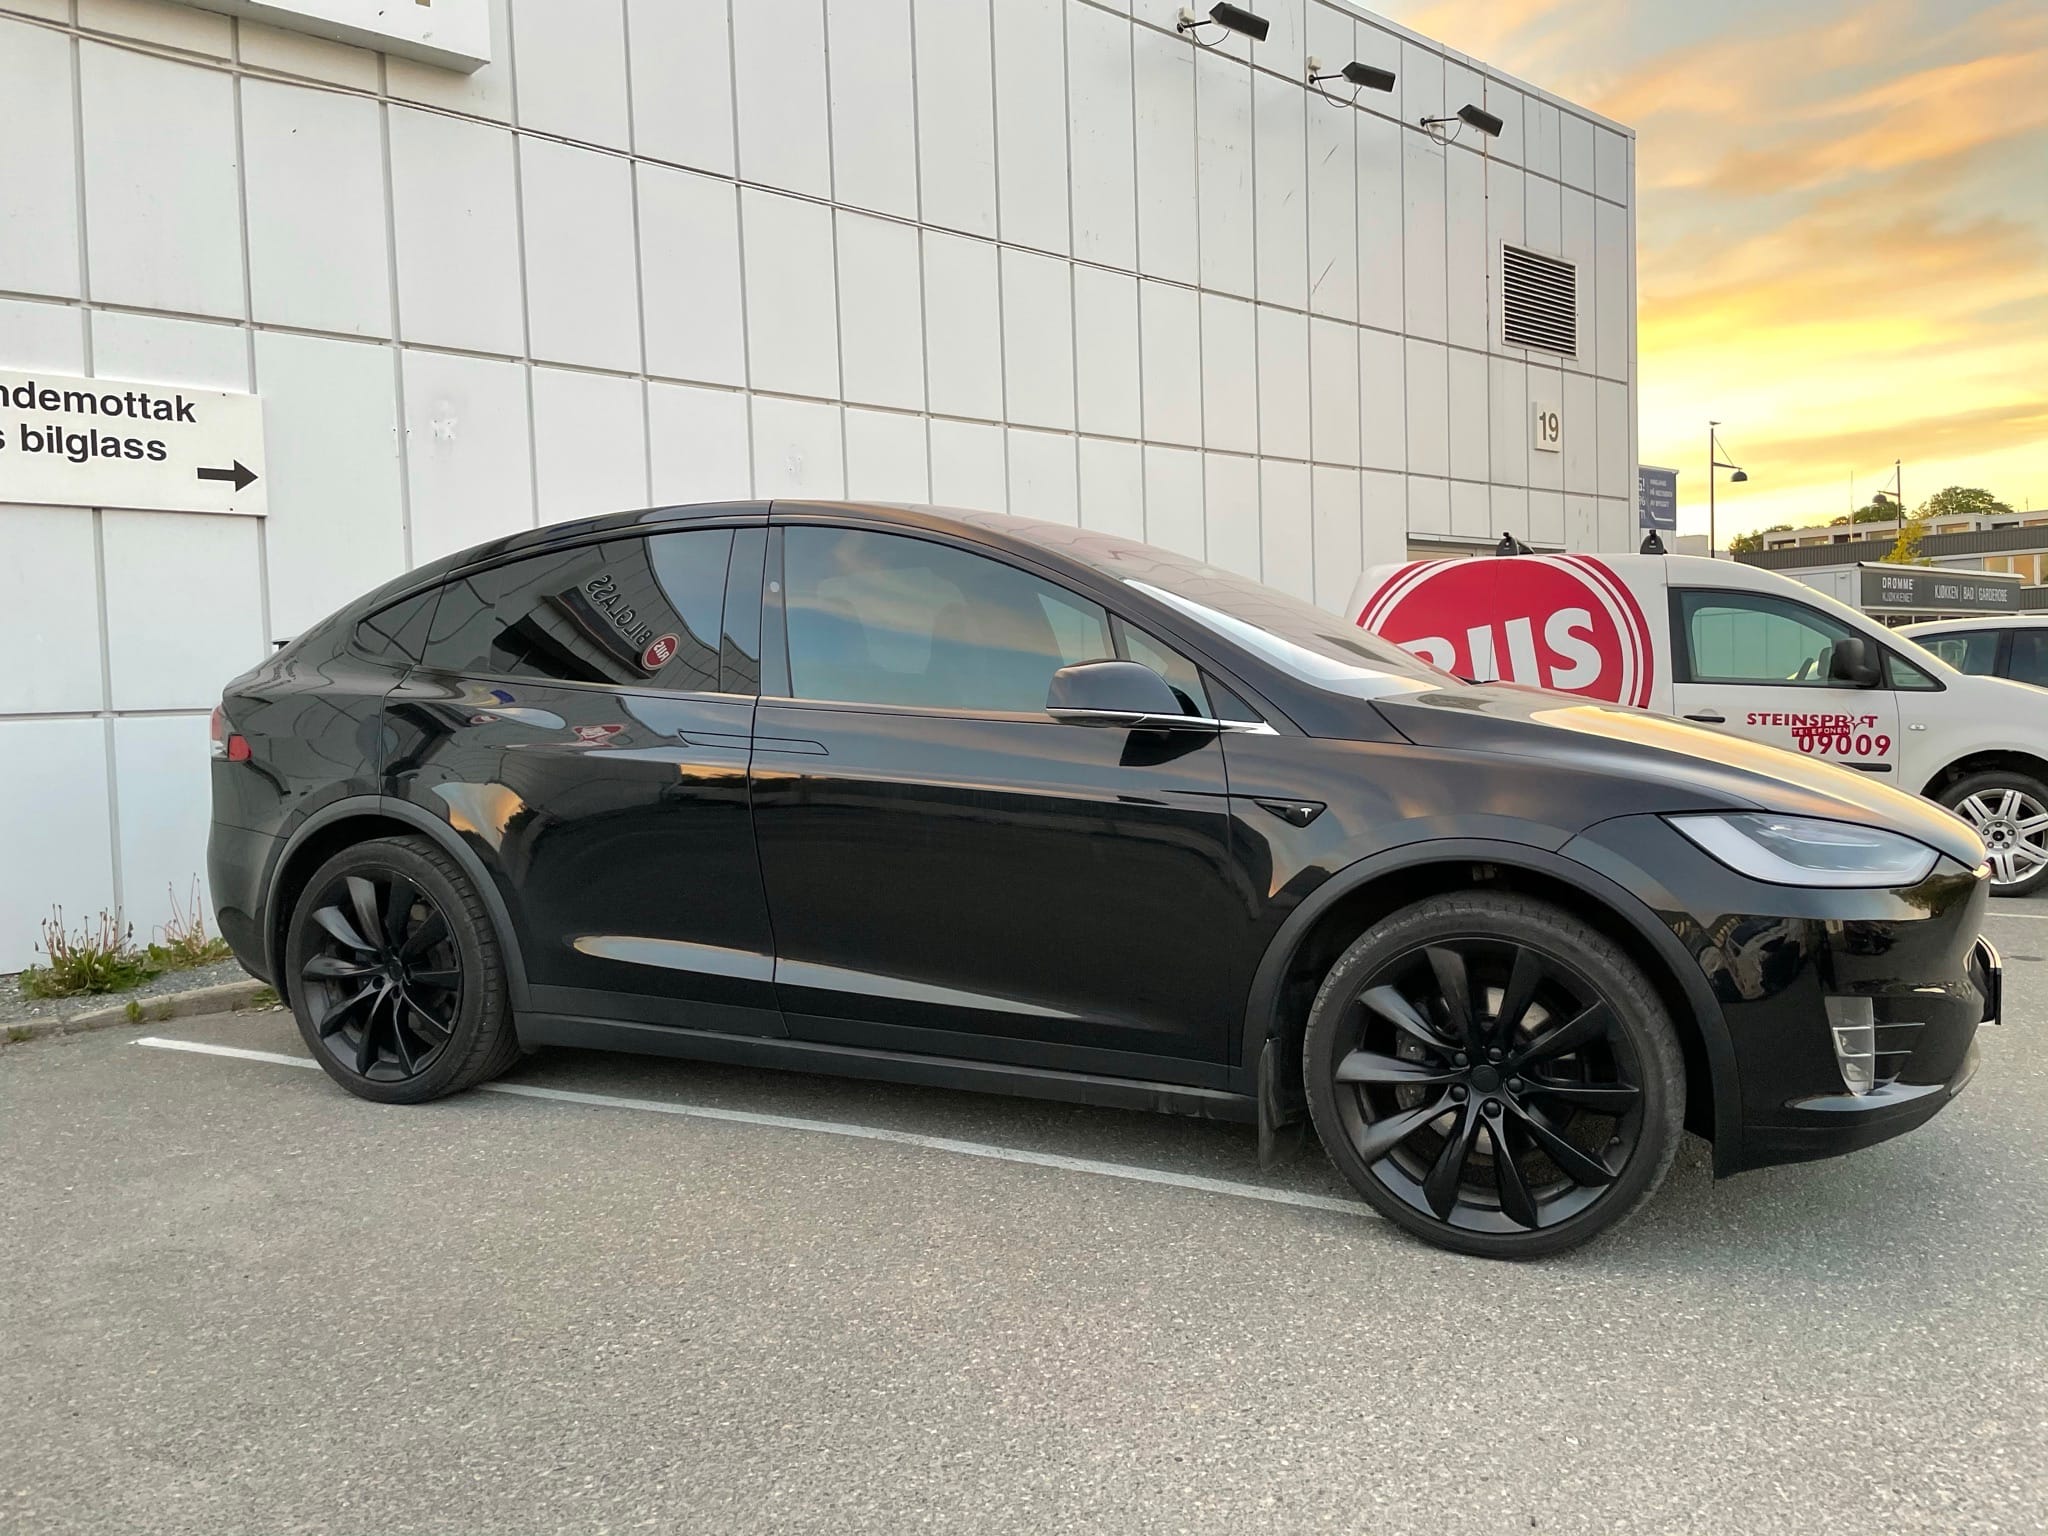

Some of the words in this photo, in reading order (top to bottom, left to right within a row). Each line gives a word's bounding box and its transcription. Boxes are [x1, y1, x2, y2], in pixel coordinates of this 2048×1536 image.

[1539, 411, 1559, 442] 19
[20, 423, 167, 463] bilglass
[1882, 577, 1913, 590] DRØMME
[1934, 585, 1959, 599] KJØKKEN
[1963, 586, 1974, 600] BAD
[1978, 588, 2008, 602] GARDEROBE
[1798, 734, 1891, 757] 09009
